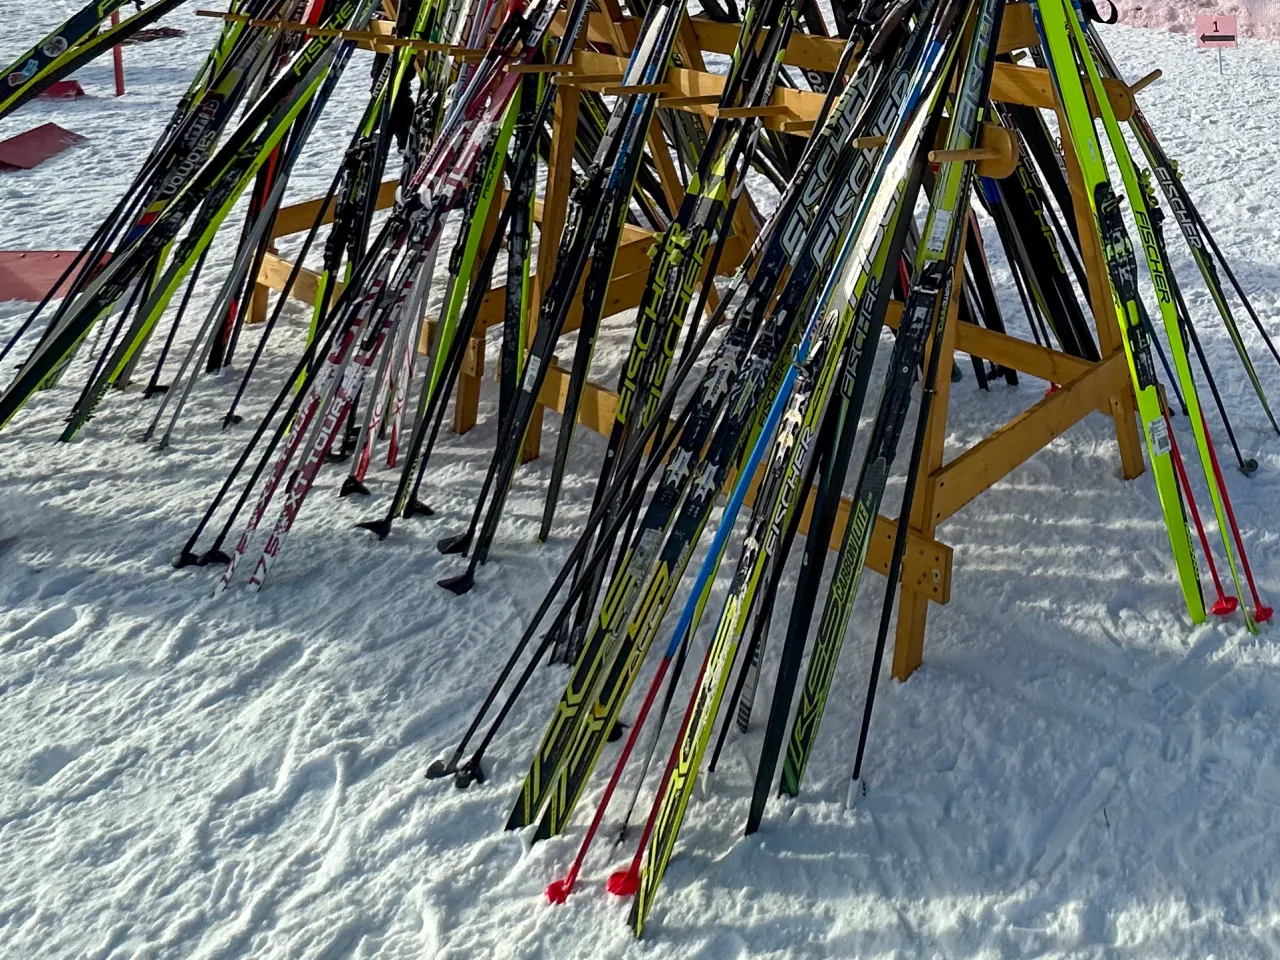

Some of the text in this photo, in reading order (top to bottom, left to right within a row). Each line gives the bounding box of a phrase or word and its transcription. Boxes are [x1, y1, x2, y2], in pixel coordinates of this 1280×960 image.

[1212, 21, 1219, 32] 1
[163, 130, 216, 195] salomon
[483, 152, 500, 199] FISCHER
[1154, 166, 1202, 250] FISCHER
[1135, 210, 1171, 304] FISCHER
[616, 223, 681, 425] FISCHER
[642, 230, 709, 428] FISCHER
[840, 276, 881, 401] FISCHER
[281, 397, 316, 460] TOUR
[368, 405, 381, 433] XC
[758, 359, 787, 427] FISCHER
[249, 397, 346, 586] 175 XT TOUR
[765, 425, 813, 556] FISCHER
